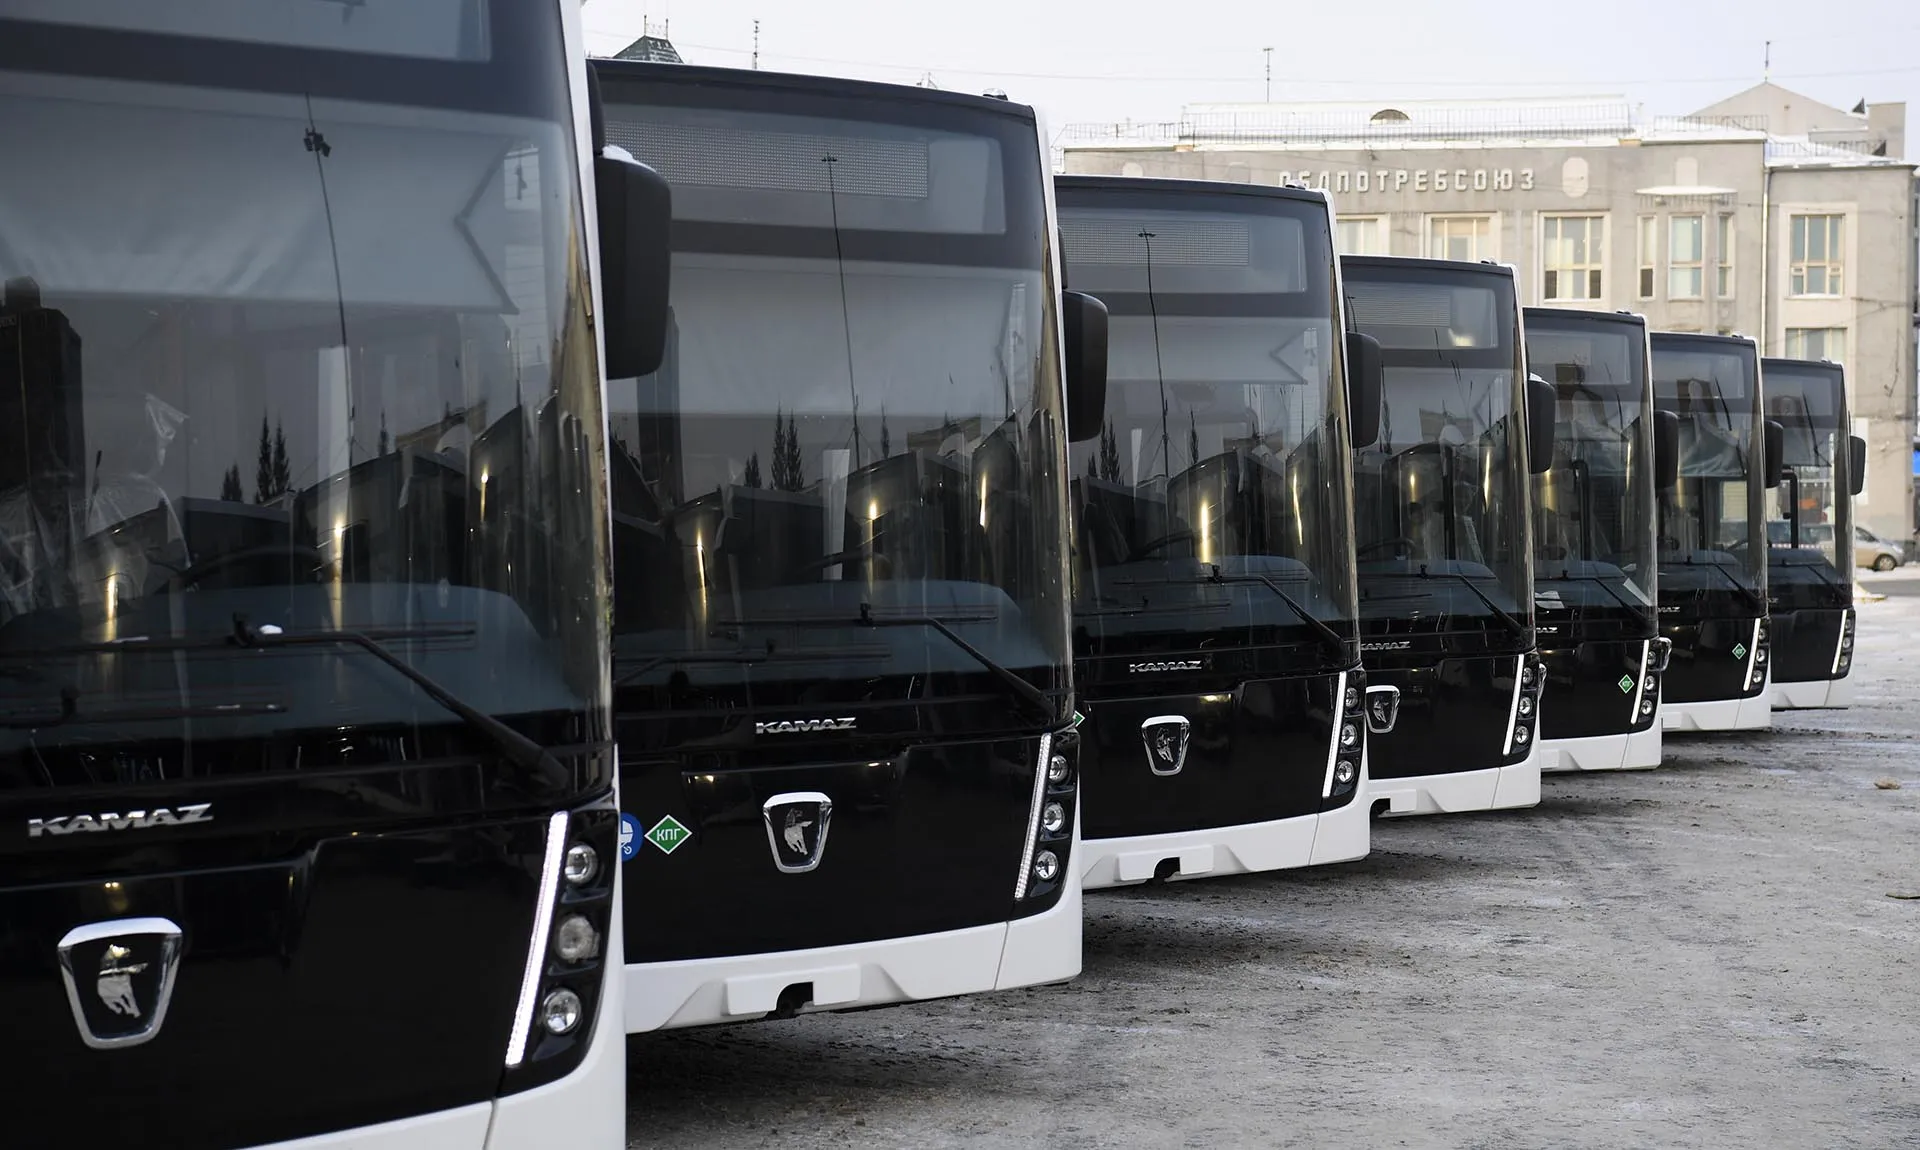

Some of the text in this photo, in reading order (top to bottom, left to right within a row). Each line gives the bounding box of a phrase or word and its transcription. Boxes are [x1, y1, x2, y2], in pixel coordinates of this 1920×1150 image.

[1279, 168, 1535, 193] ОБЛПОТРЕБСОЮЗ
[1129, 660, 1202, 673] KAMAZ
[756, 717, 857, 734] KAMAZ
[28, 803, 214, 837] KAMAZ
[656, 828, 681, 841] КПГ
